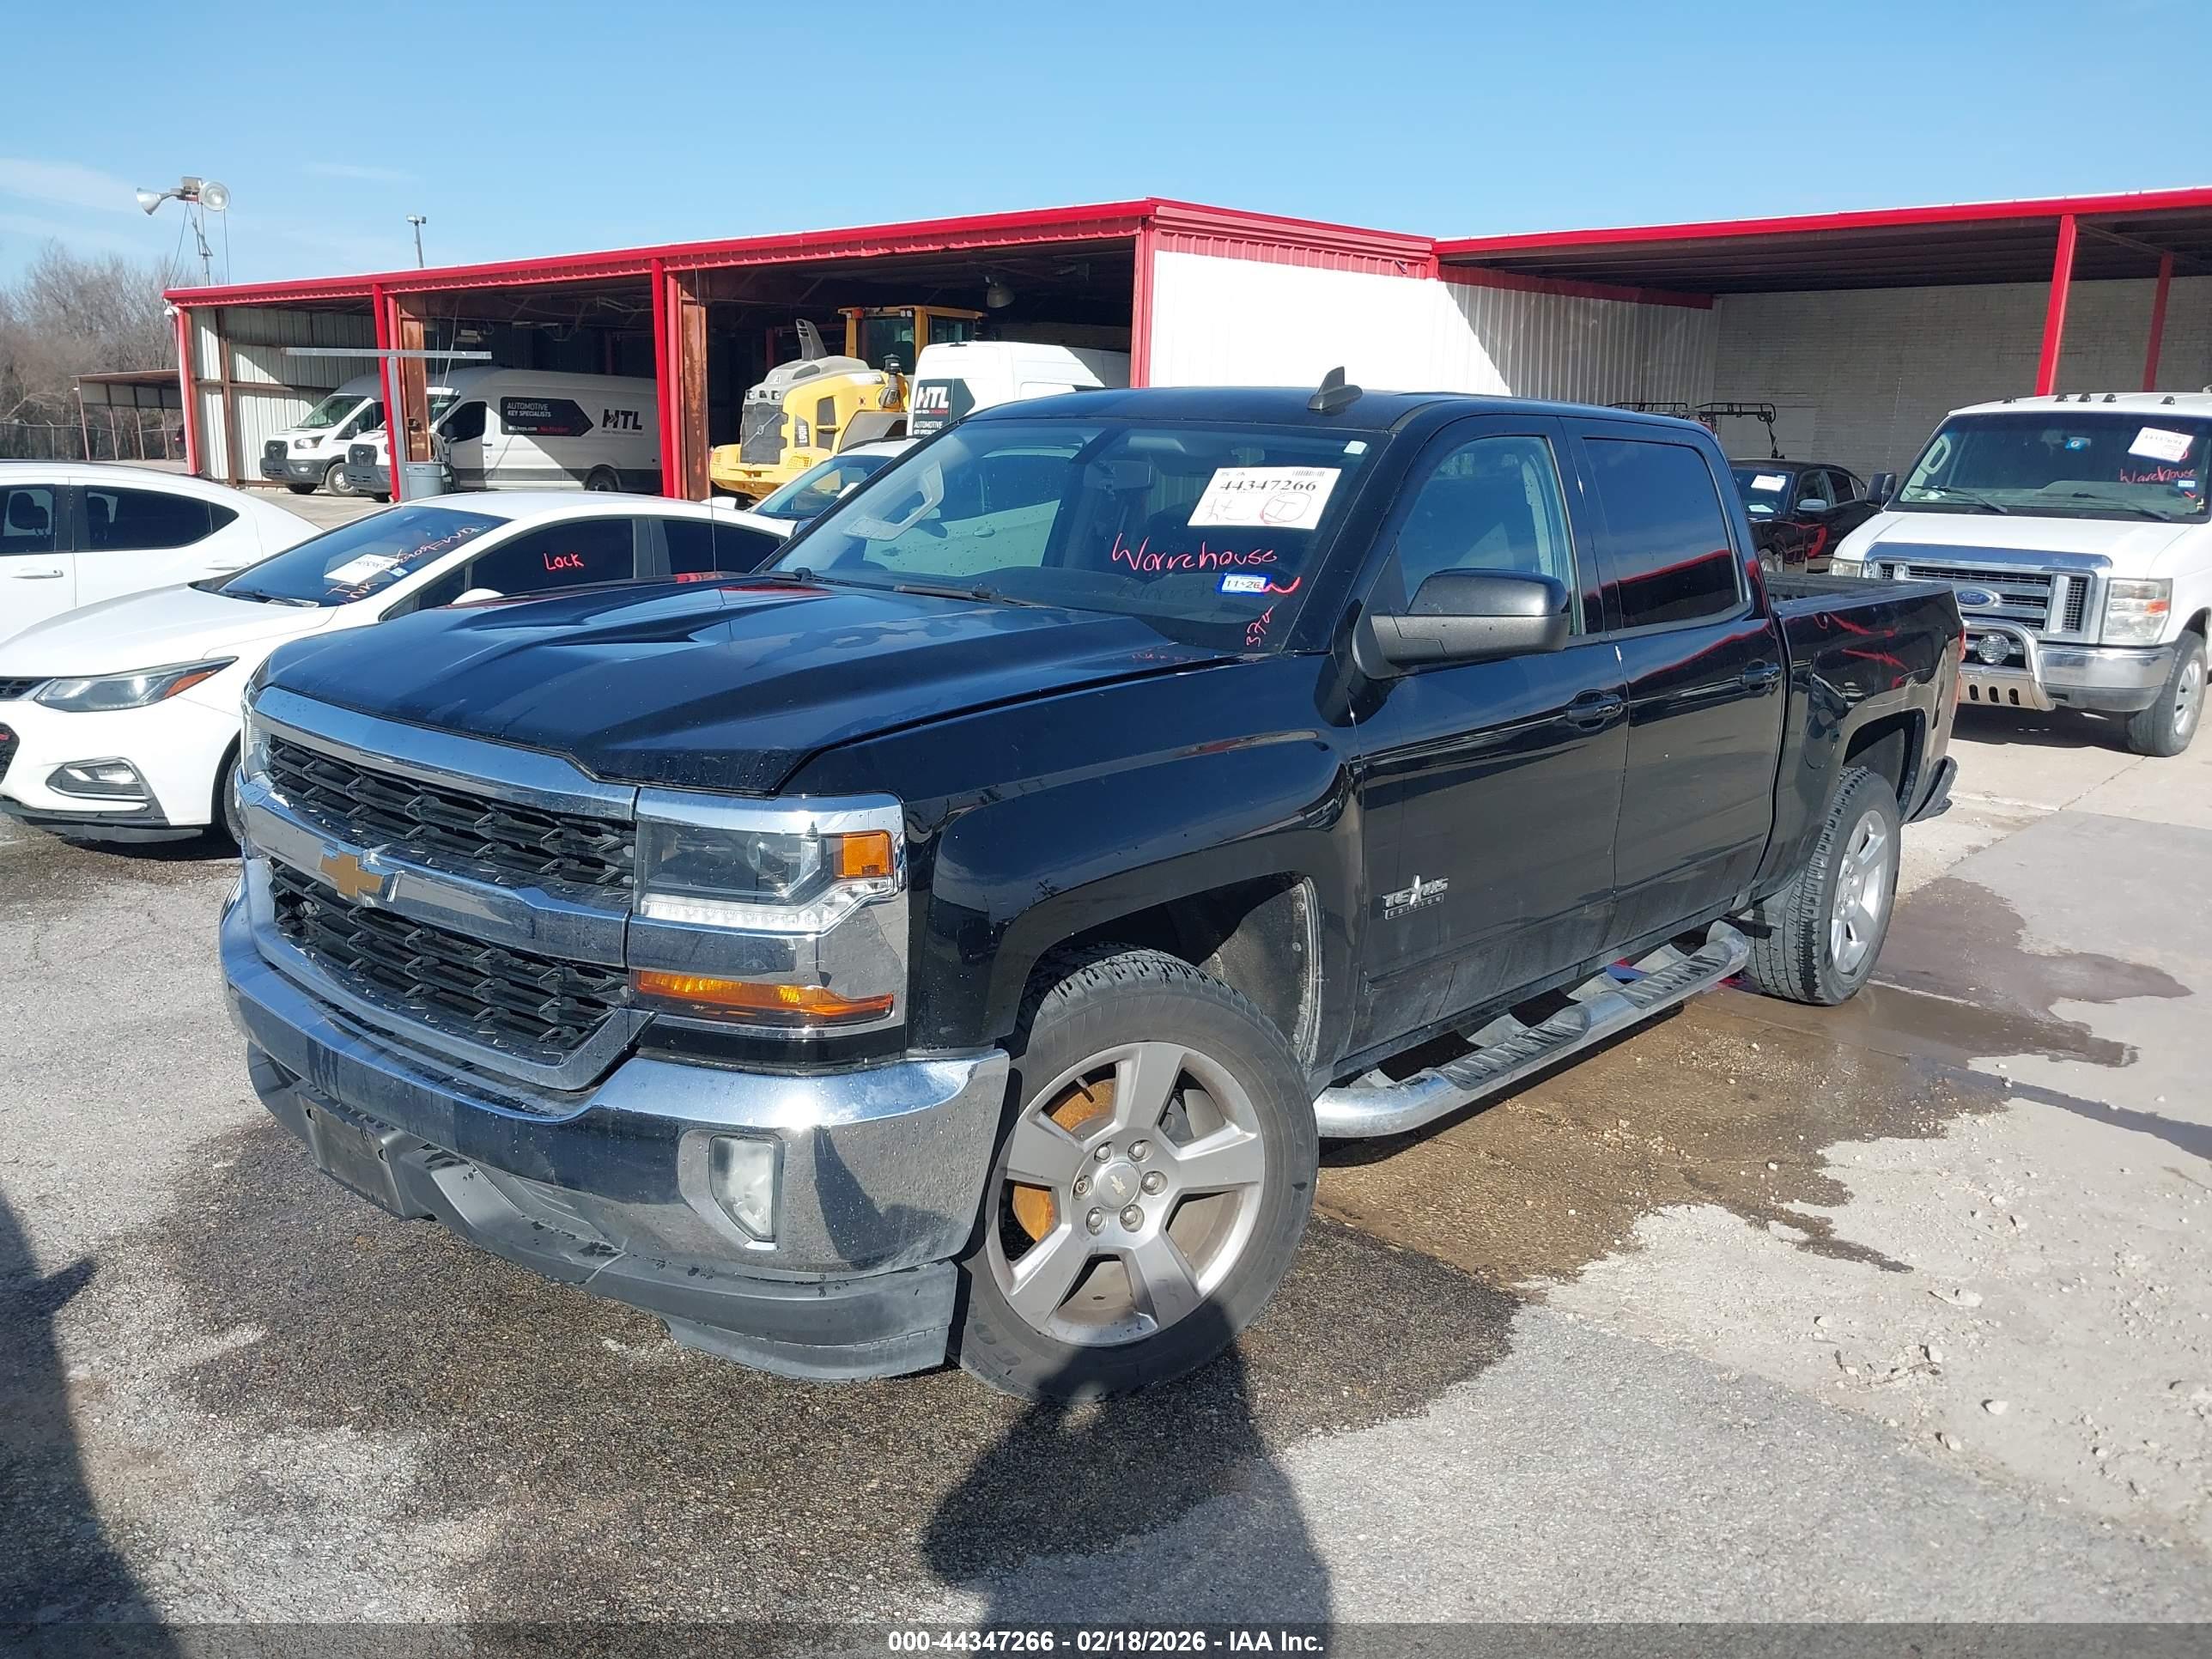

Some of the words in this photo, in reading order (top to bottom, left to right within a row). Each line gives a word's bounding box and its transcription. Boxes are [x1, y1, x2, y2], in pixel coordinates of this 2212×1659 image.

[507, 402, 550, 411] AUTOMOTIVE
[913, 420, 943, 428] AUTOMOTIVE
[1218, 480, 1318, 492] 44347266
